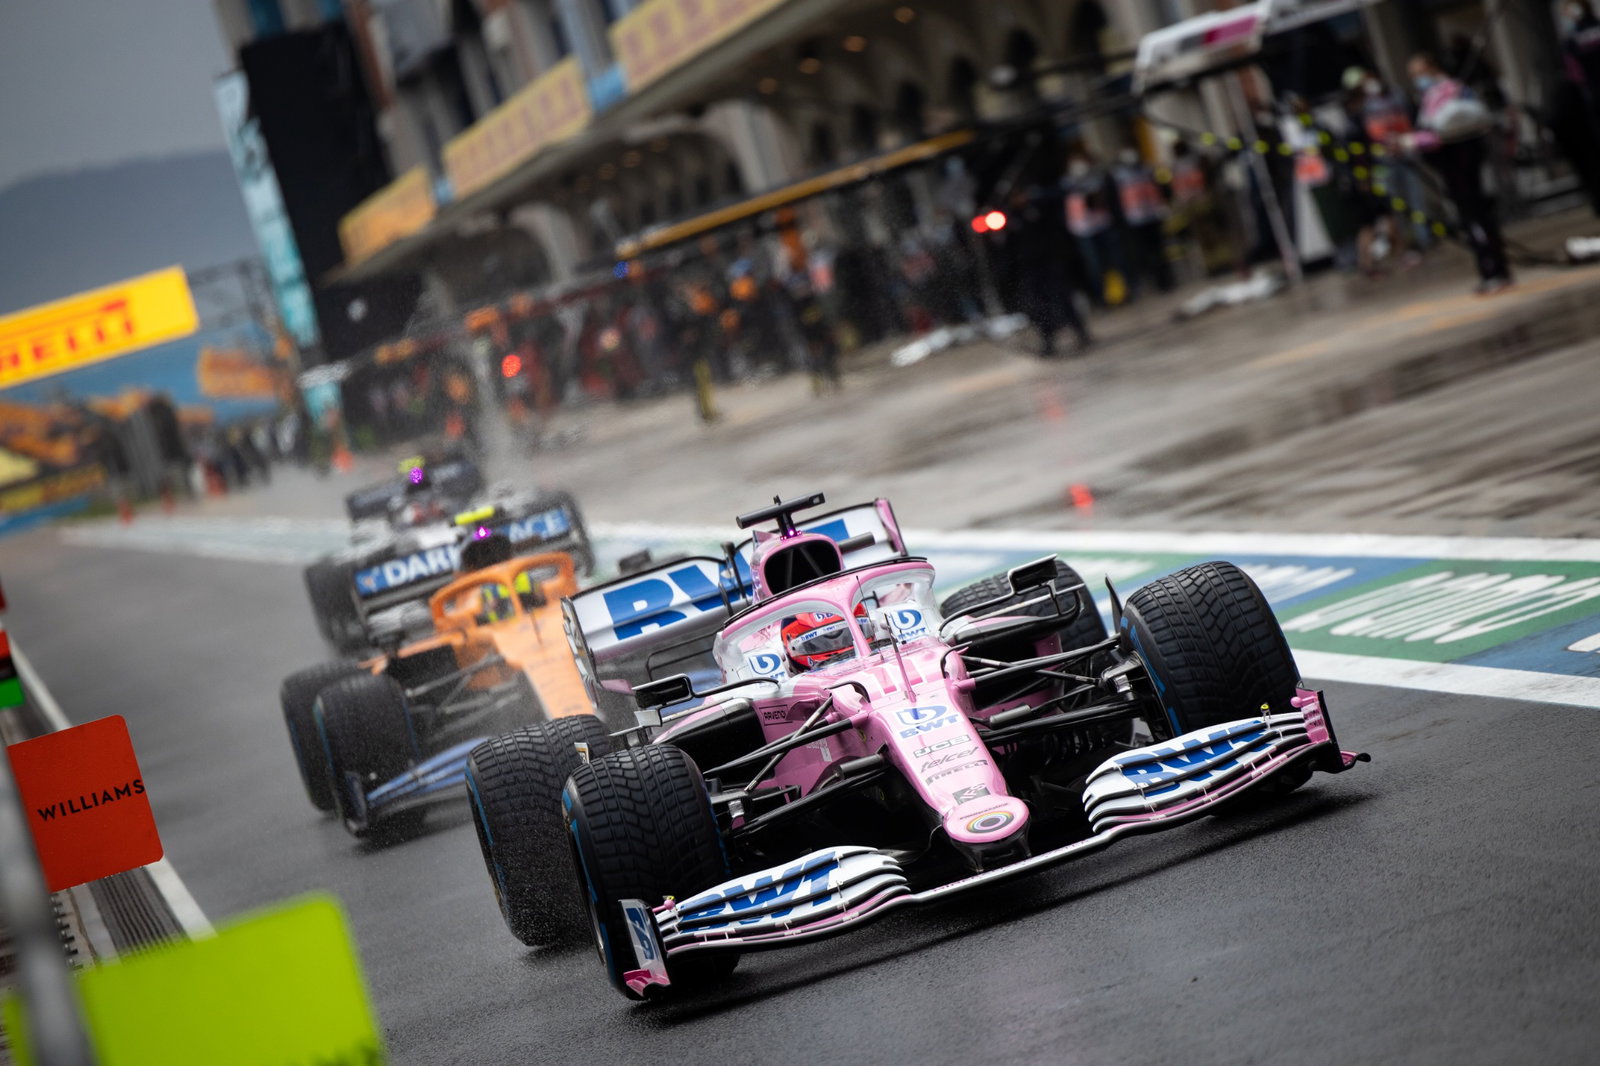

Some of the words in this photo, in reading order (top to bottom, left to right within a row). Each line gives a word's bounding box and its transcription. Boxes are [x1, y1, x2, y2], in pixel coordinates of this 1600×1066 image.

[899, 713, 959, 739] BWT
[913, 735, 971, 759] JCB
[1114, 719, 1277, 797] BWT
[37, 779, 145, 822] WILLIAMS
[679, 850, 840, 935] BWT
